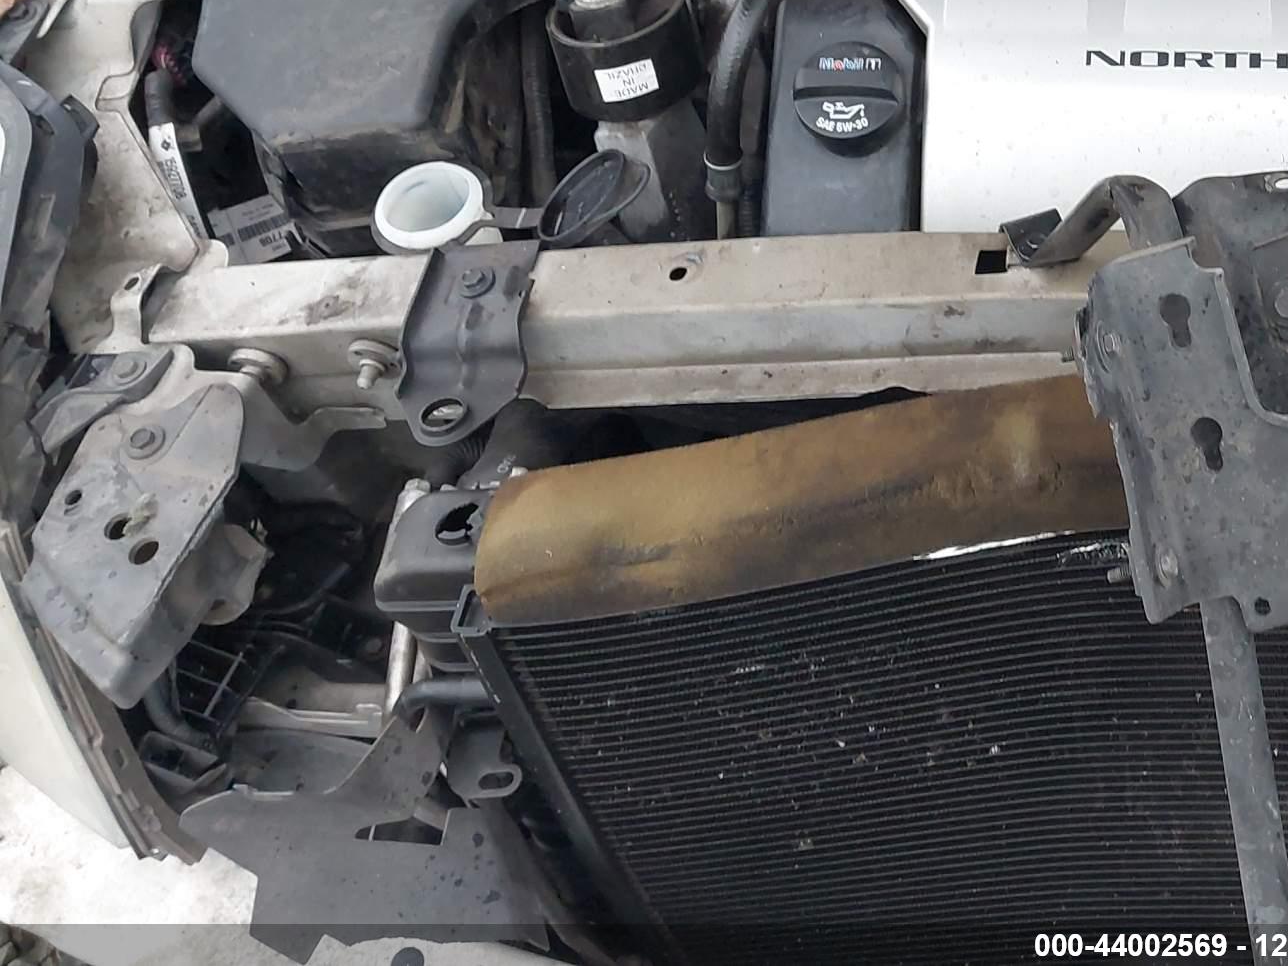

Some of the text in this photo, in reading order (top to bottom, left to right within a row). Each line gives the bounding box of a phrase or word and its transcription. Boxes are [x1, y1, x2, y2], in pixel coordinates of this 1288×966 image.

[818, 57, 864, 71] Mobil
[615, 81, 649, 98] MADE
[623, 77, 635, 87] IN
[816, 116, 869, 133] SAE 5W-30
